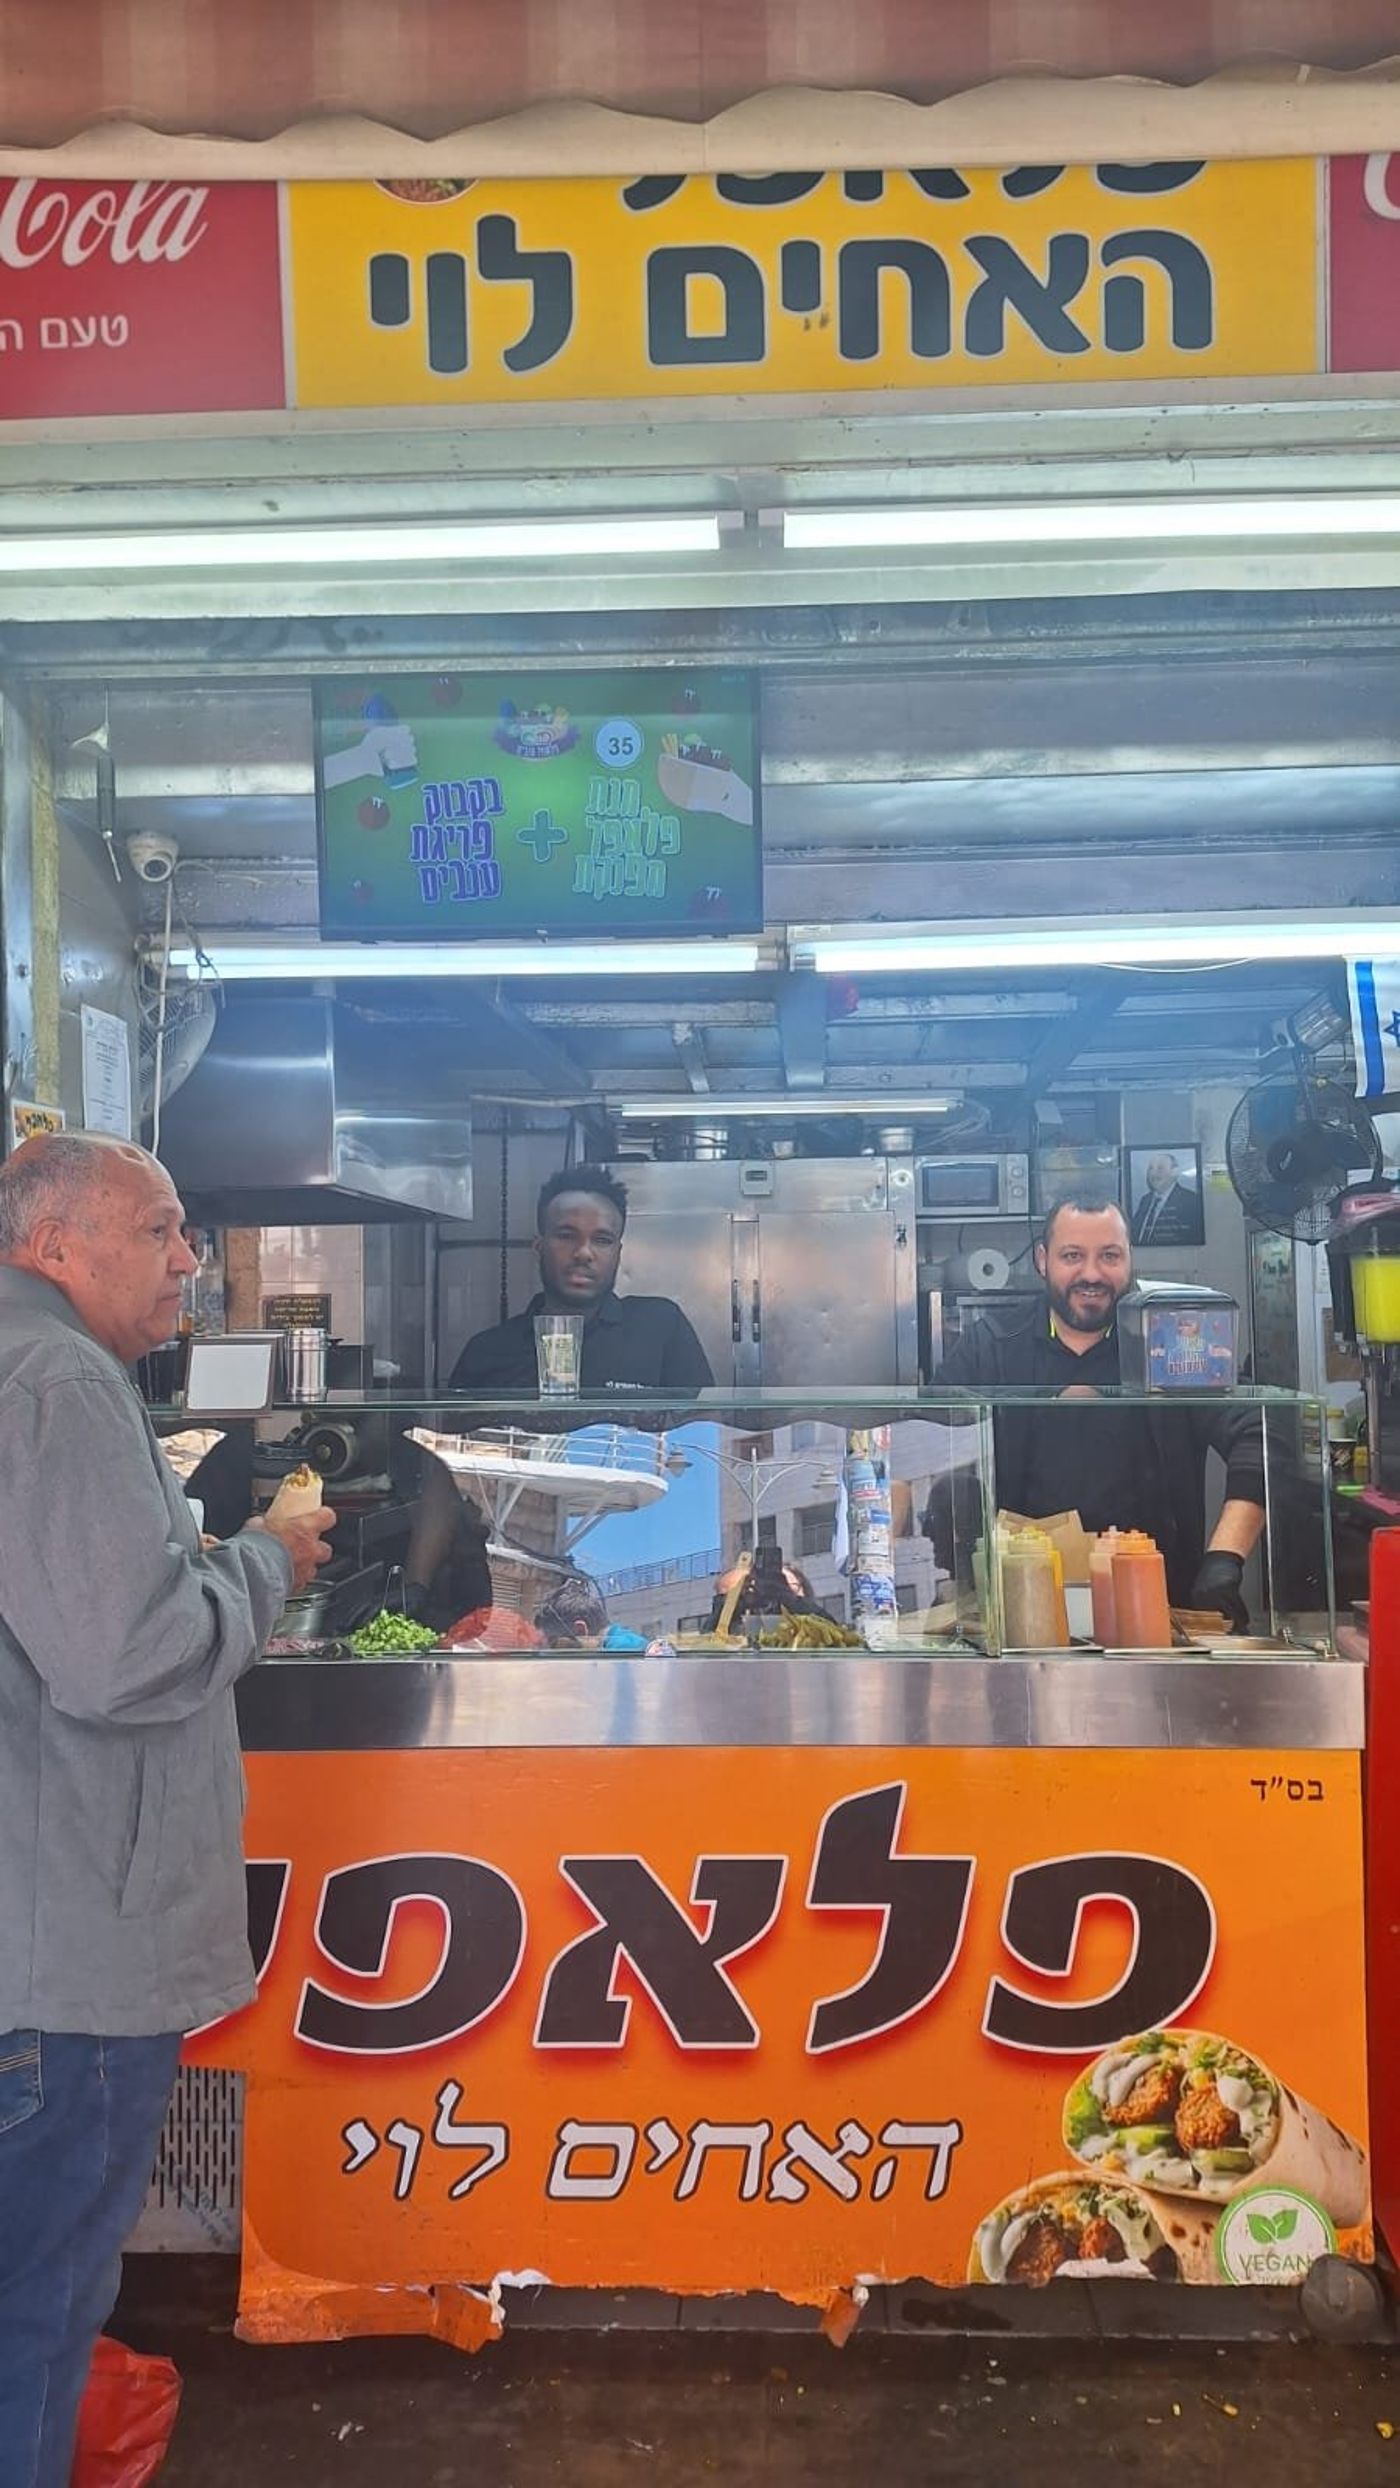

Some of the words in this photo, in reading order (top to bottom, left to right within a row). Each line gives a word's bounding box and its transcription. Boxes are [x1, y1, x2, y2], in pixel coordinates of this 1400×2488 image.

[368, 212, 575, 376] לוי
[648, 228, 1215, 366] האחים
[40, 314, 129, 349] טעם
[608, 736, 635, 757] 35
[421, 777, 505, 825] בקבוק
[584, 776, 641, 817] מנת
[408, 819, 494, 862] פריגת
[585, 805, 681, 859] פלאפל
[418, 858, 502, 903] ענבים
[340, 2077, 510, 2203] לוי
[546, 2116, 964, 2203] האחים
[1239, 2252, 1312, 2278] VEGAN
